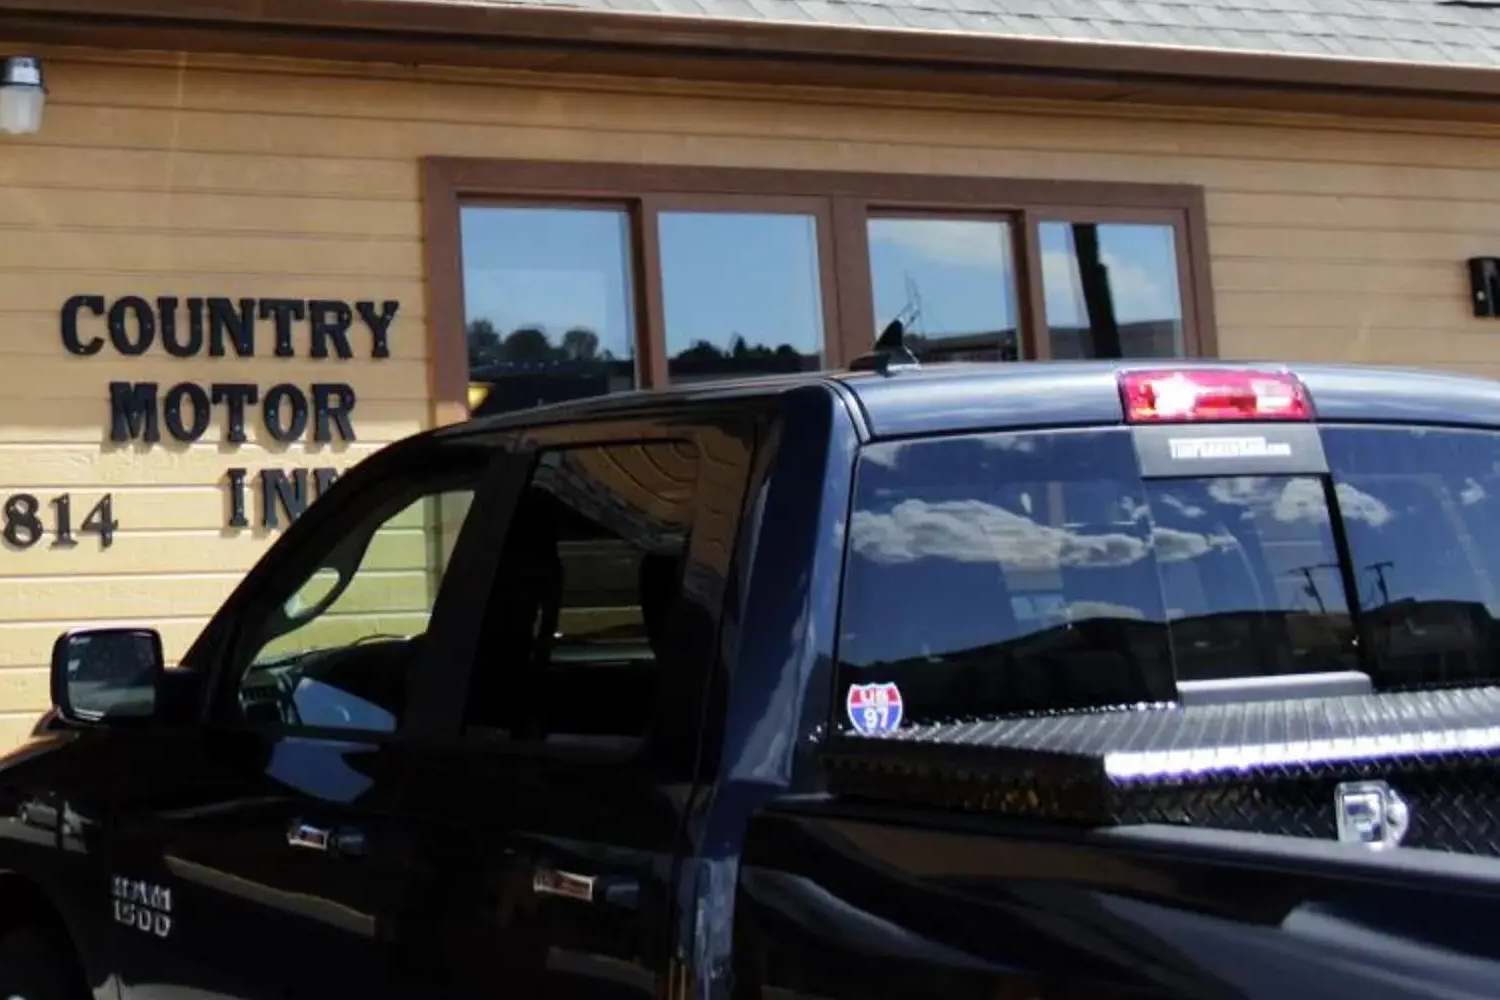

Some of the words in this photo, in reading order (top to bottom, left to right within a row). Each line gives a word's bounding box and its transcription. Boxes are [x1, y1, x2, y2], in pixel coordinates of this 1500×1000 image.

[60, 295, 399, 358] COUNTRY
[109, 381, 357, 443] MOTOR
[2, 492, 119, 549] 814
